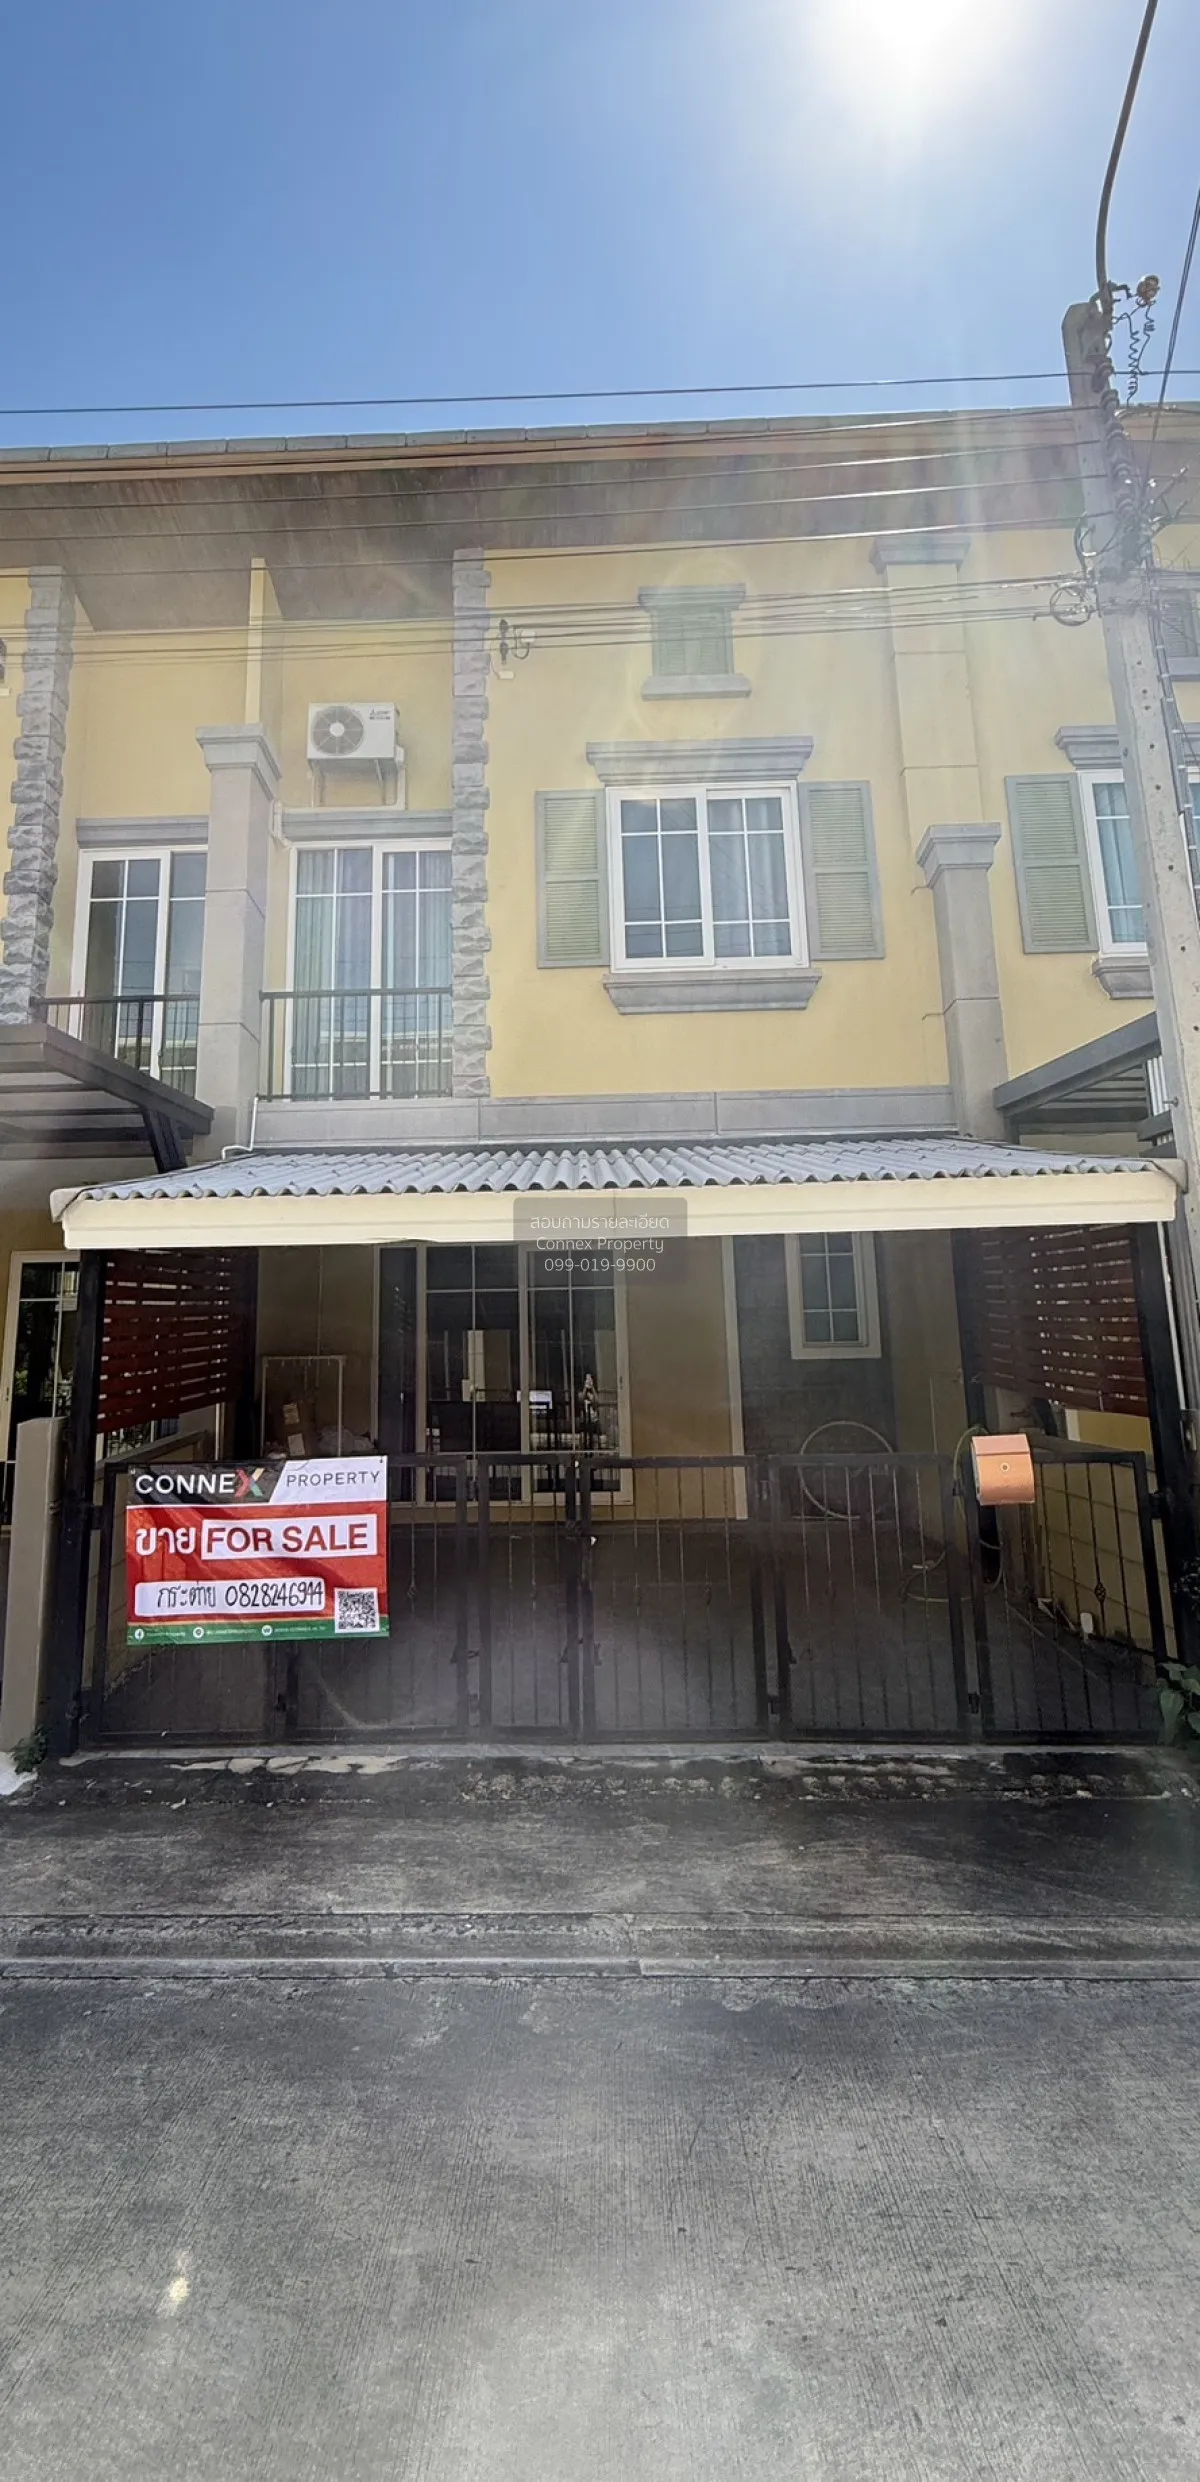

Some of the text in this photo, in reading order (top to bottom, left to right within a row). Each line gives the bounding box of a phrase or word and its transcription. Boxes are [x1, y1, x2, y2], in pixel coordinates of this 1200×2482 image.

[135, 1467, 380, 1497] CONNEX PROPERTY
[135, 1523, 368, 1556] ขาย FOR SALE
[225, 1580, 323, 1608] 0828246944
